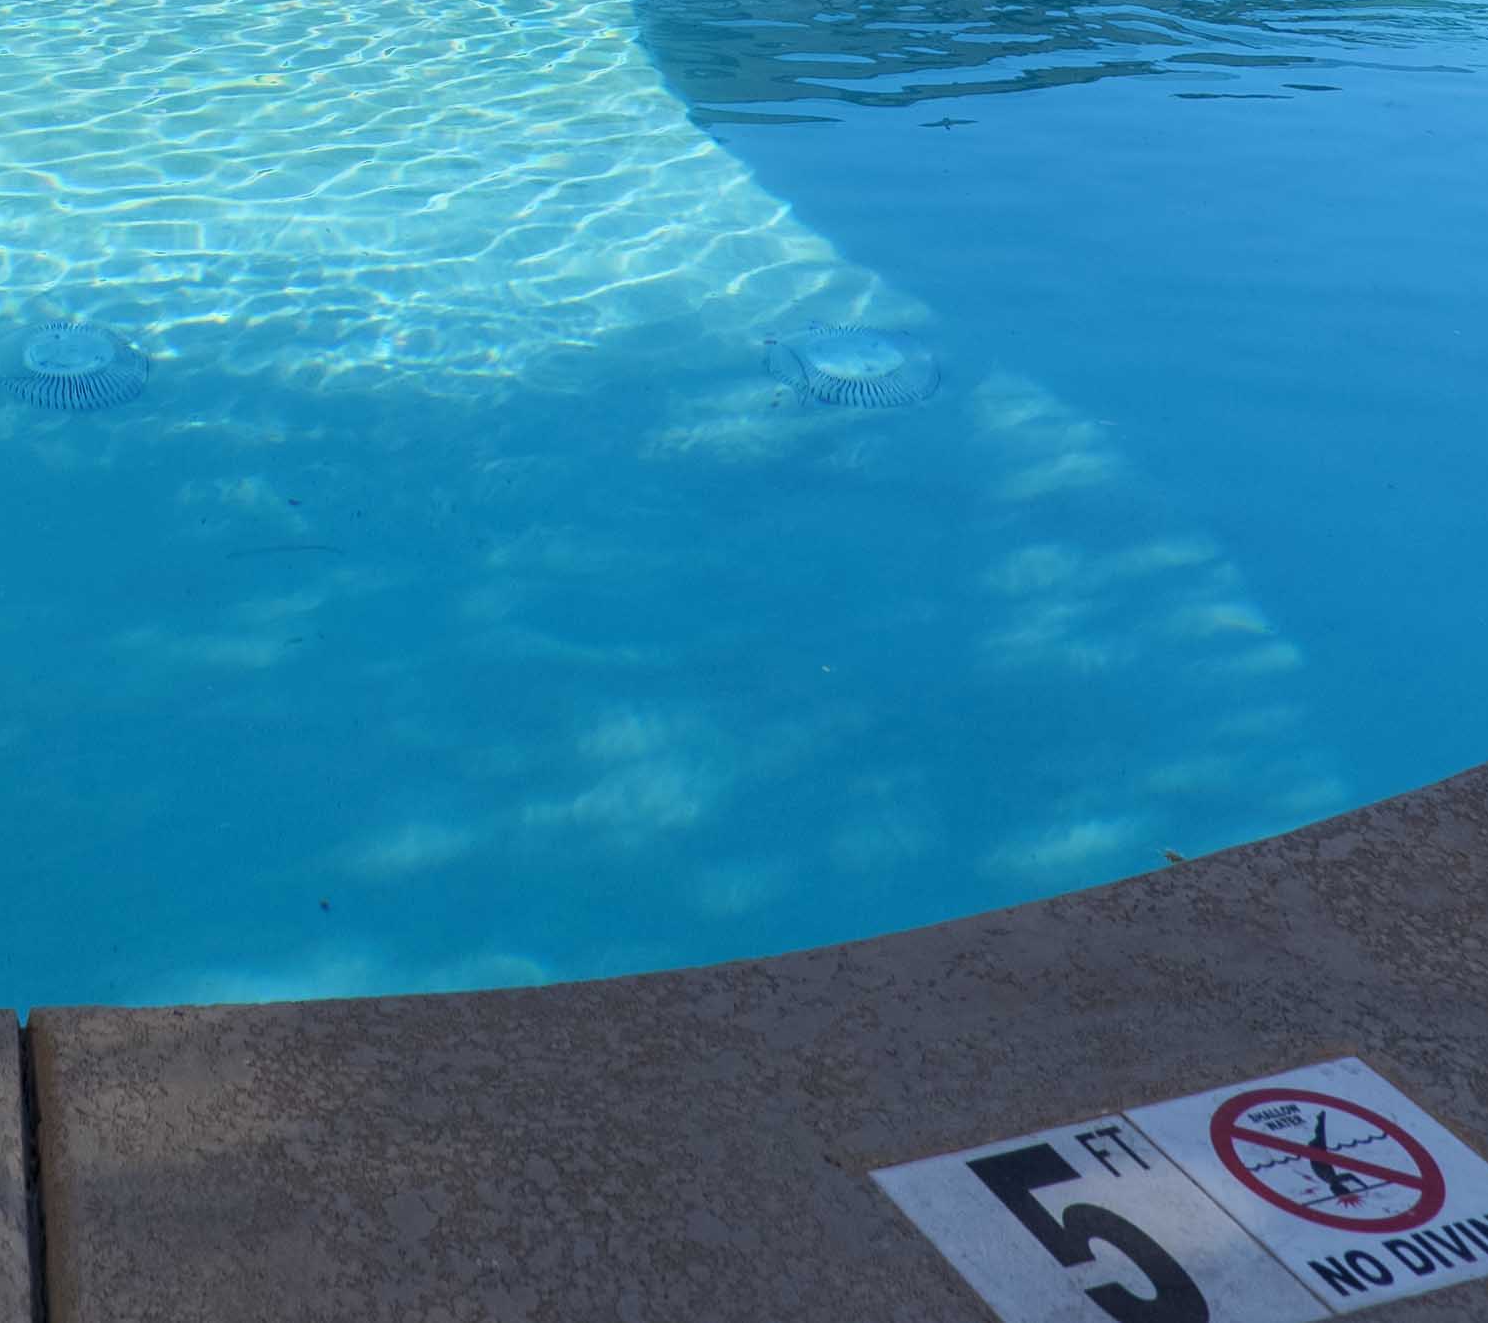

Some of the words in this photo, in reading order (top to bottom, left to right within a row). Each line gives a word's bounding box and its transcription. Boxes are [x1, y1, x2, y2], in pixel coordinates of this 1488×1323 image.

[1075, 1125, 1151, 1177] FT
[965, 1142, 1210, 1323] 5
[1307, 1249, 1395, 1297] NO
